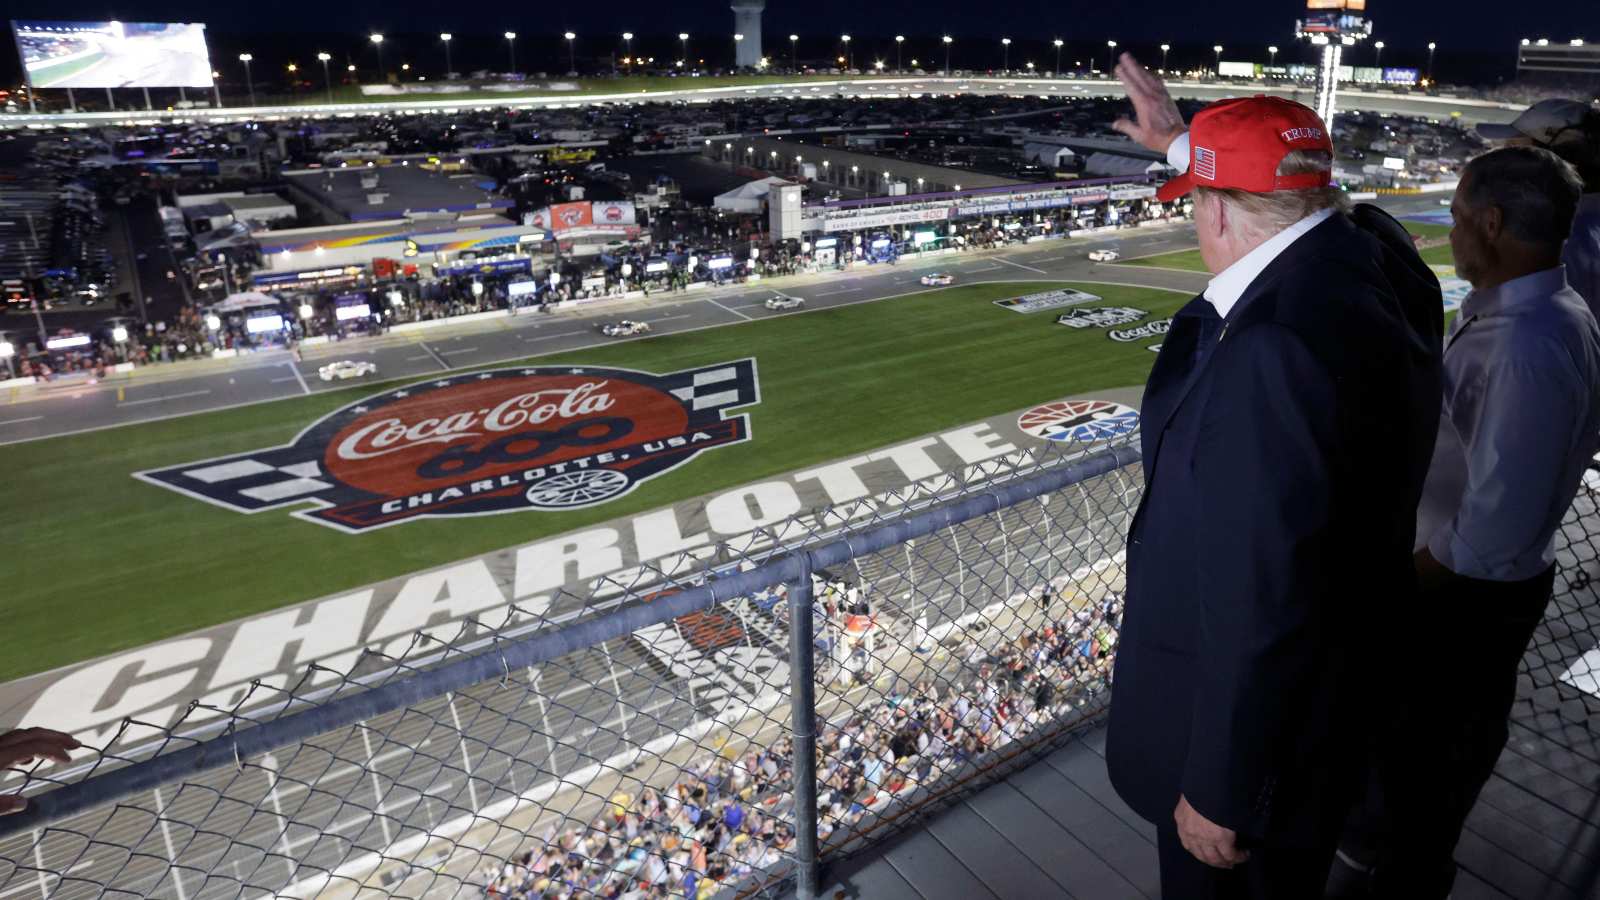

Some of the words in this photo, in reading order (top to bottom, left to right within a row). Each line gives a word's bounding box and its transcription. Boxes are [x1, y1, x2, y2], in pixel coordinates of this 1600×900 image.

[1281, 127, 1321, 141] TRUMP
[337, 380, 616, 459] Coca-Cola
[417, 416, 634, 479] 600
[381, 451, 630, 514] CHARLOTTE,
[643, 431, 712, 453] USA
[14, 423, 1018, 736] CHARLOTTE
